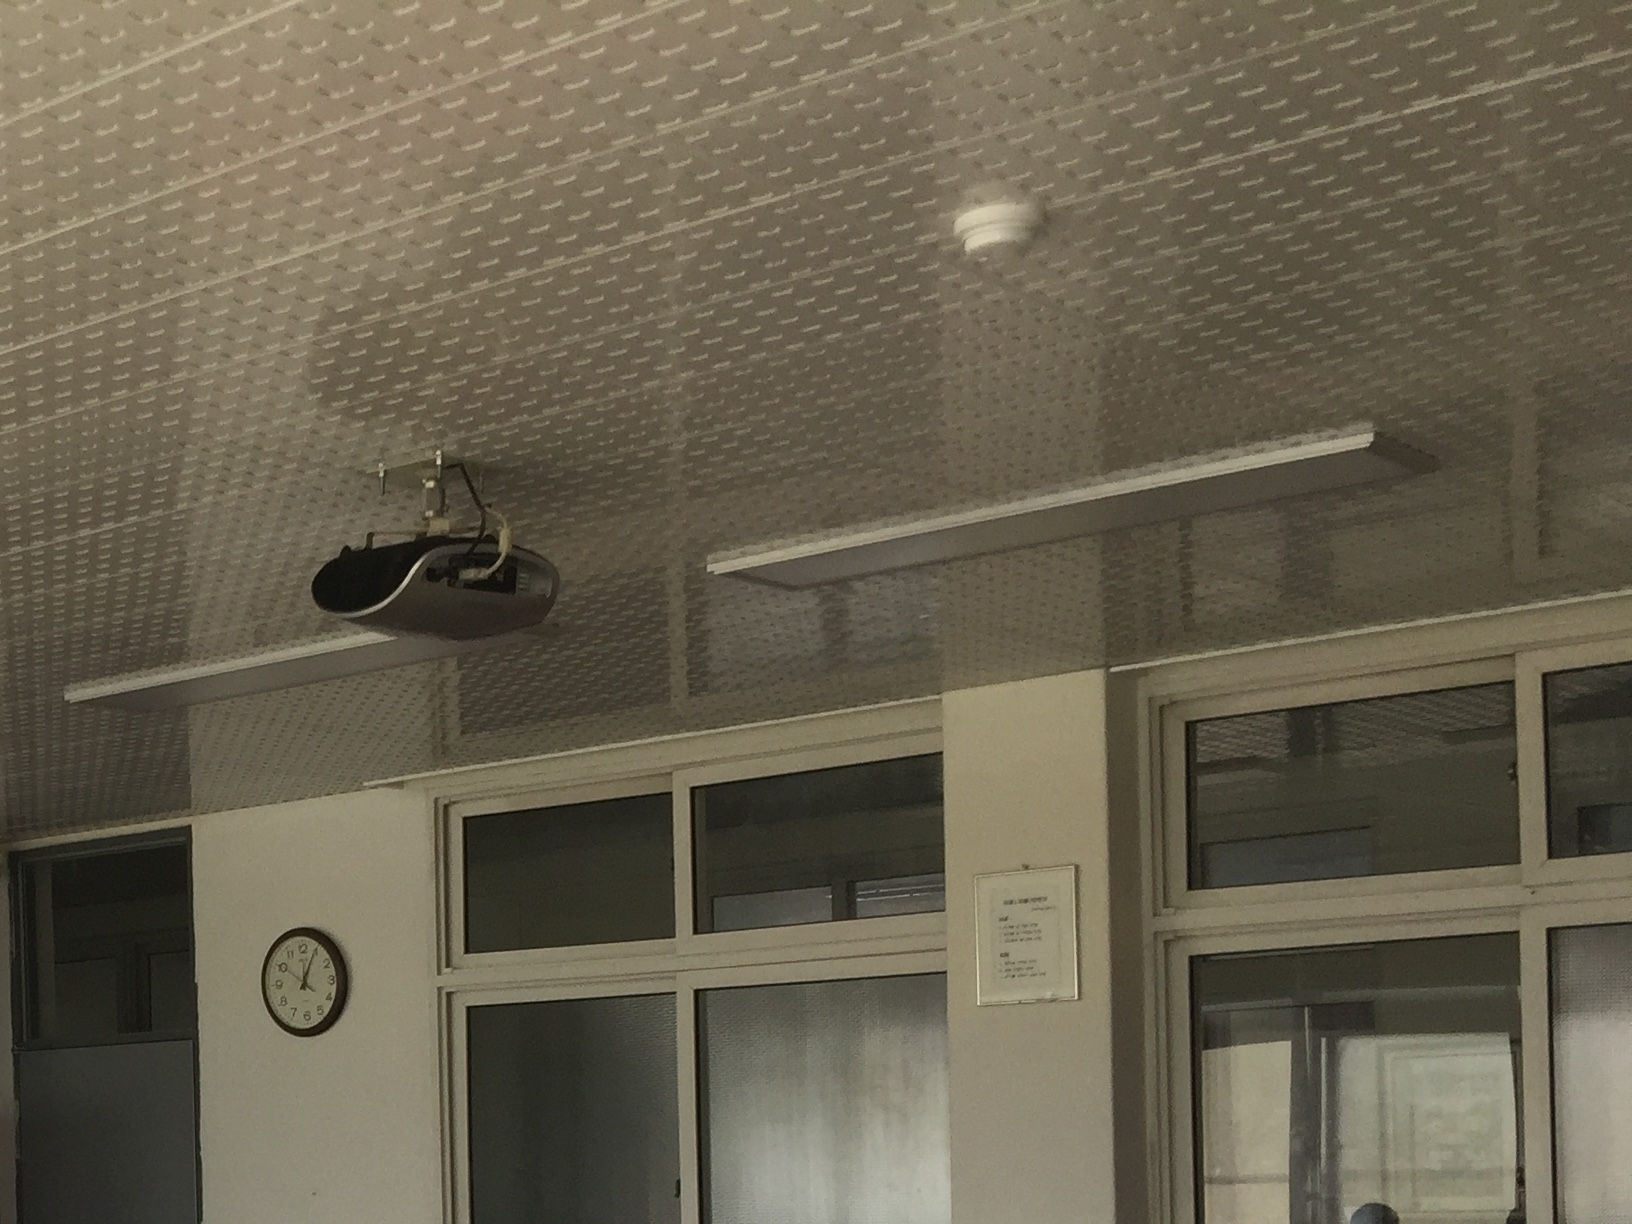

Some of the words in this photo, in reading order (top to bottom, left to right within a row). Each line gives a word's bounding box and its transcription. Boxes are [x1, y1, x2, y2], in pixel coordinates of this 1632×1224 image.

[277, 961, 288, 973] 10
[323, 957, 331, 969] 2
[275, 979, 284, 990] 9
[327, 974, 336, 986] 3
[279, 995, 288, 1007] 8
[325, 991, 333, 1002] 4
[290, 1007, 298, 1018] 7
[303, 1010, 312, 1022] 6
[316, 1004, 325, 1016] 5
